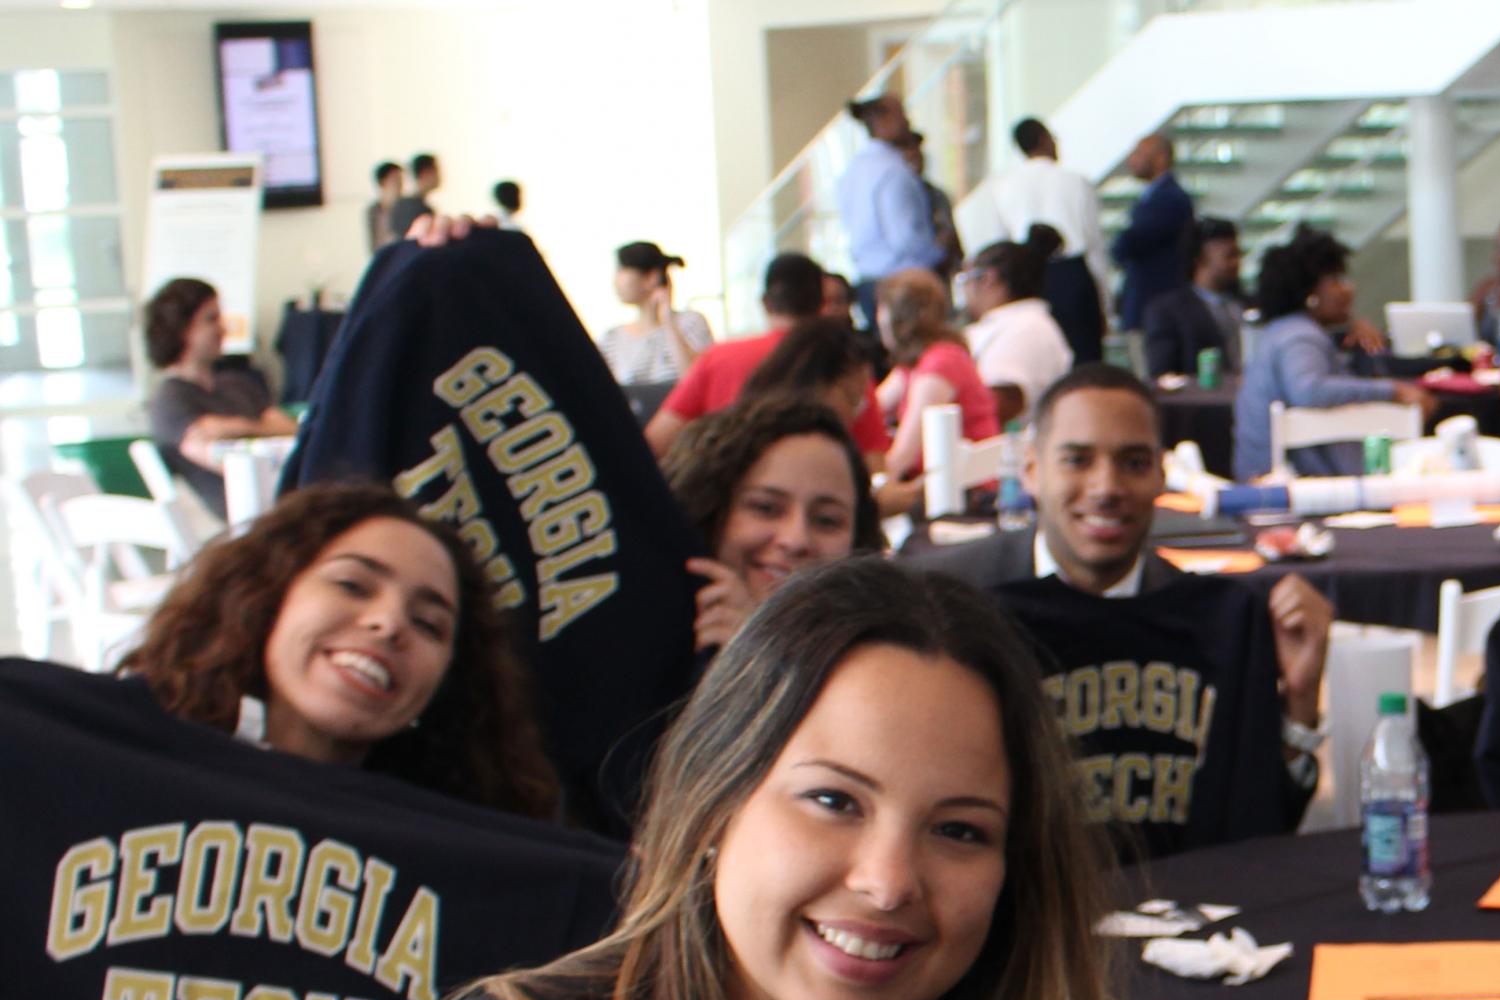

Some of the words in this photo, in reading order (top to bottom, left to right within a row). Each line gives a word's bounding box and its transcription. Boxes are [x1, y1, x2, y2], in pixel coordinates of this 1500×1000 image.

[432, 346, 621, 643] GEORGIA
[1039, 659, 1218, 746] ORGI
[1072, 752, 1196, 824] ECH
